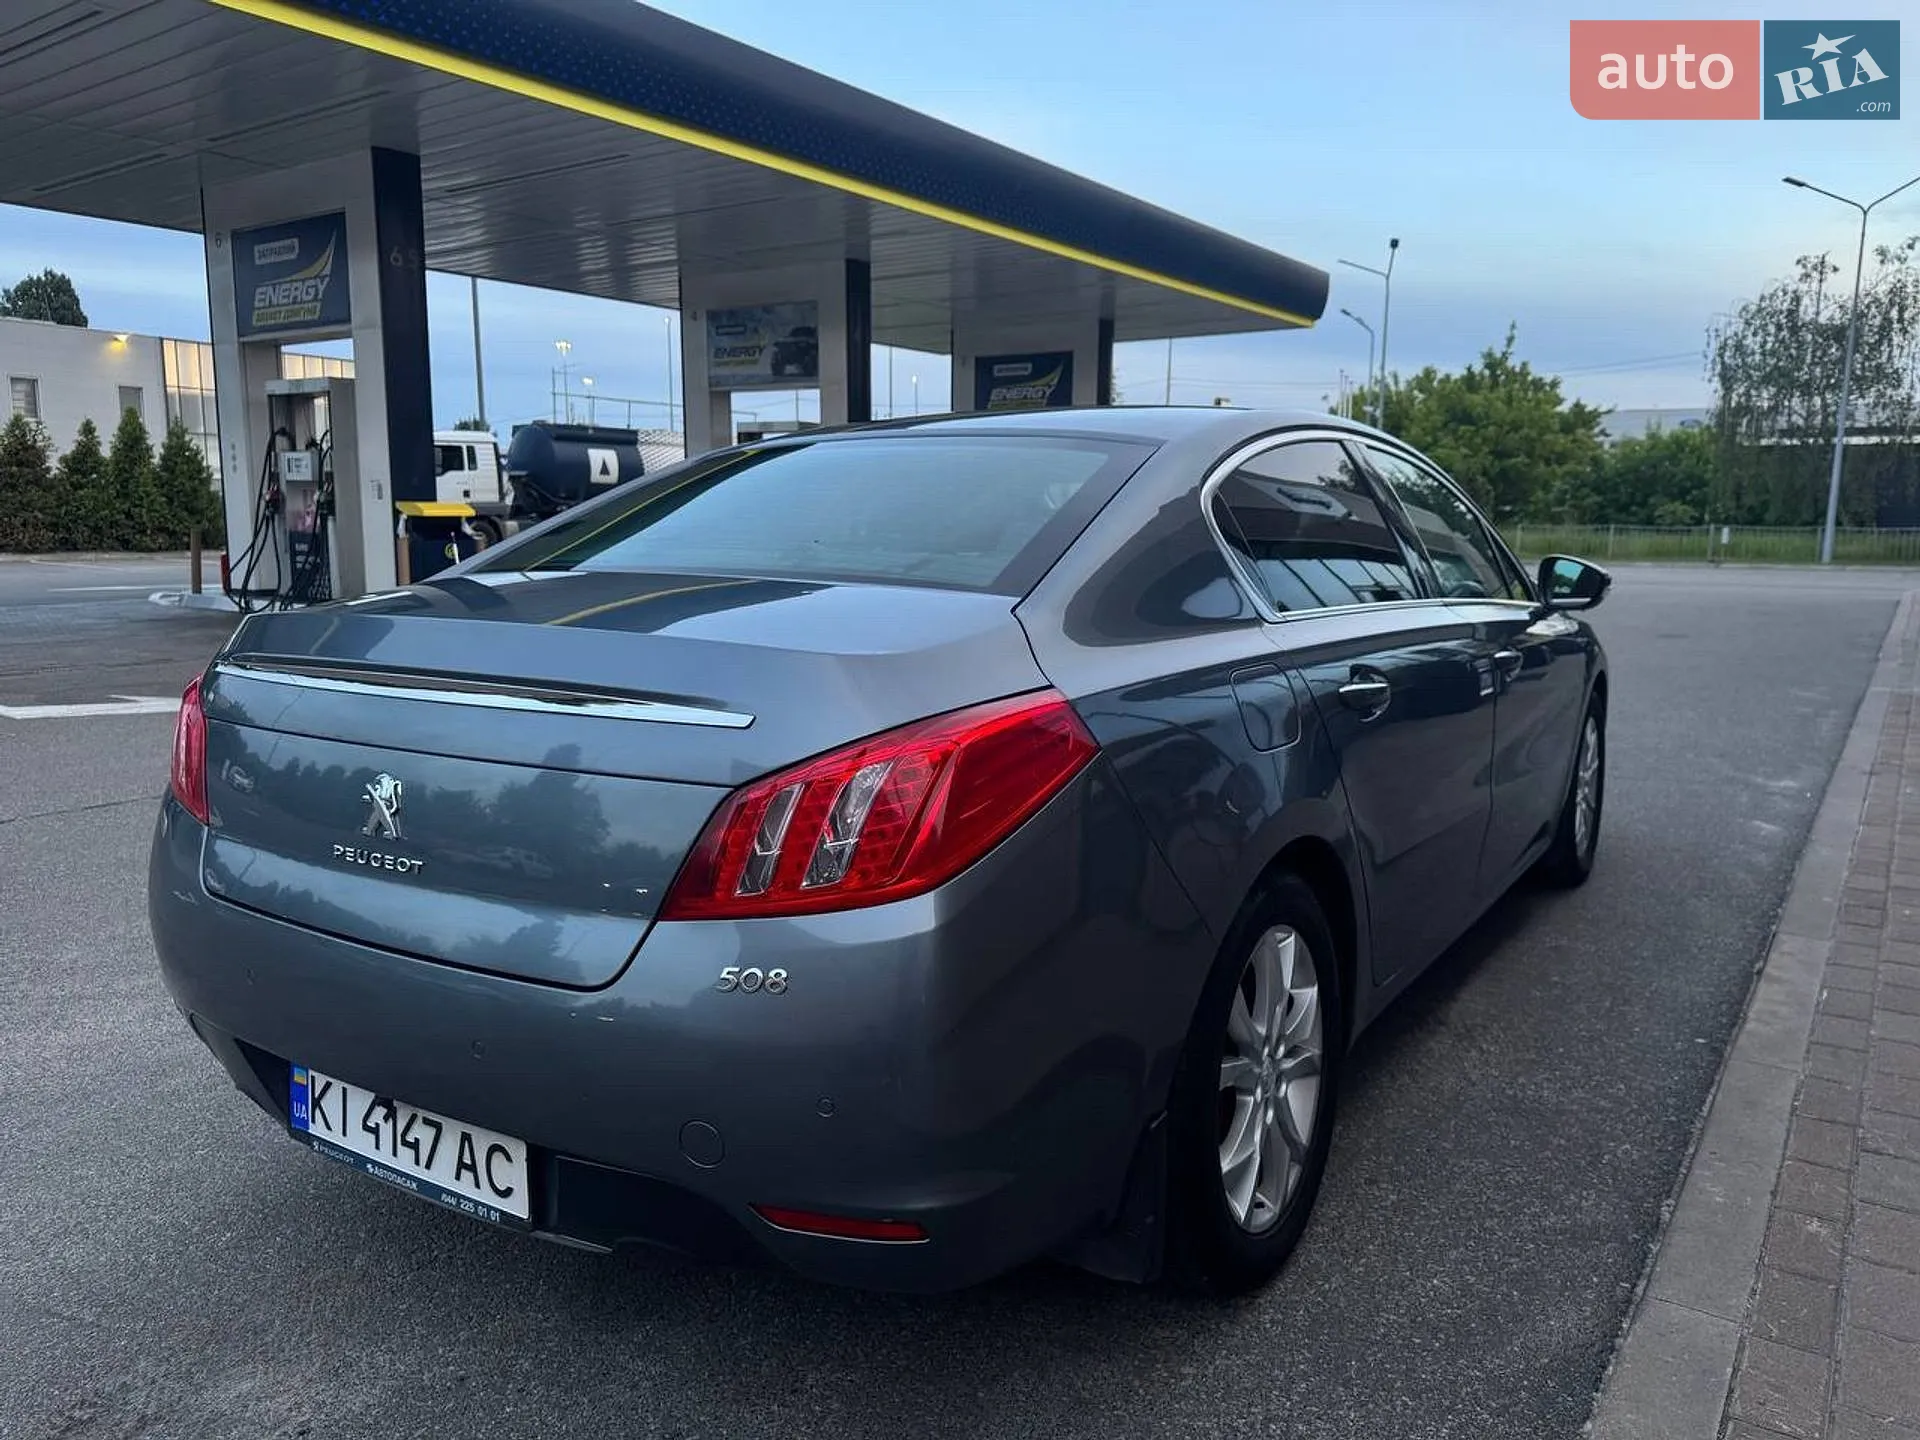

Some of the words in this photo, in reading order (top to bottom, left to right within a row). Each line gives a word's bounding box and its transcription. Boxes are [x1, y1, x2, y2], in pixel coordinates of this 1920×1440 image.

[254, 276, 330, 308] ENERGY
[990, 385, 1057, 401] ENERGY
[332, 844, 424, 875] PEUGEOT
[714, 966, 789, 995] 508
[293, 1101, 308, 1120] UA
[310, 1074, 348, 1138] KI
[361, 1096, 443, 1171] 4147
[454, 1130, 514, 1199] AC
[490, 1211, 500, 1222] 01
